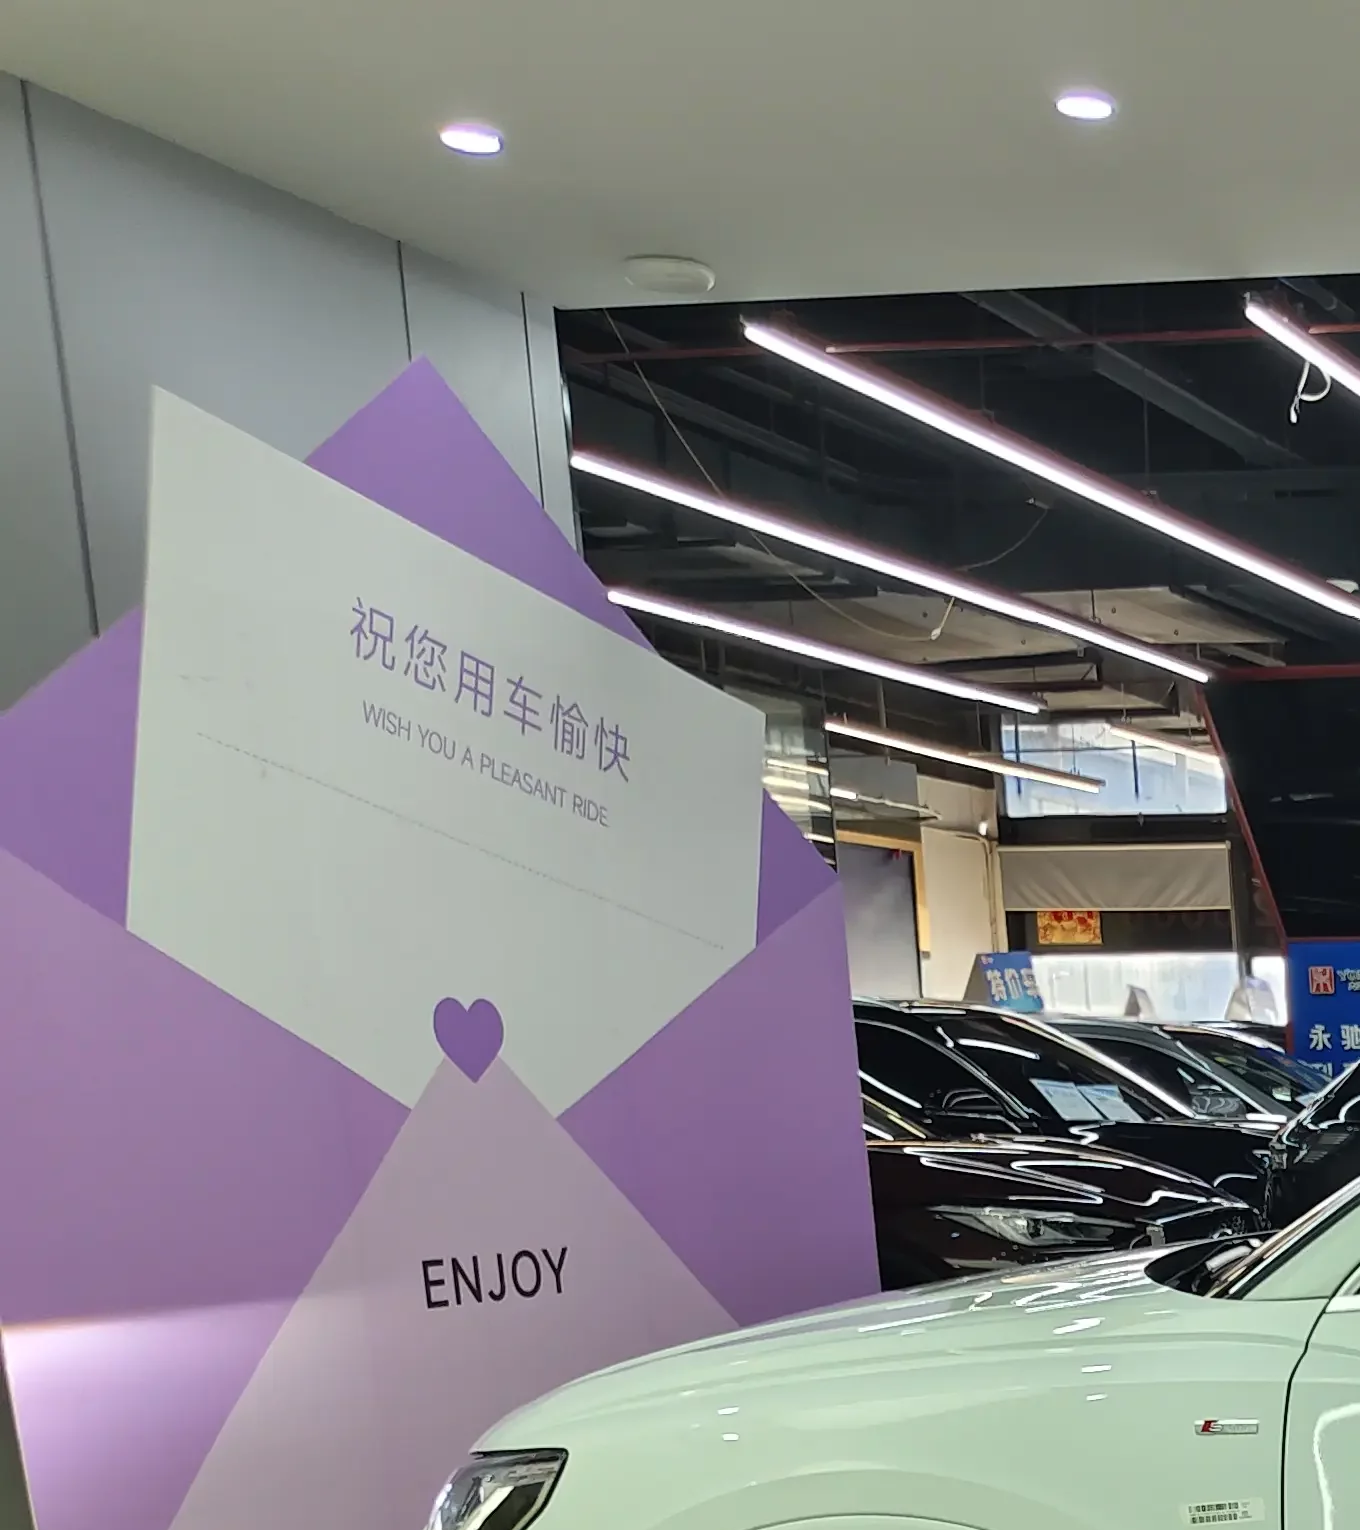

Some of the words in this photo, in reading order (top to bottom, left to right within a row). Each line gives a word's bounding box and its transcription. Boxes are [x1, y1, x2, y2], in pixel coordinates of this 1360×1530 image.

[350, 596, 631, 783] 祝您用车愉快
[362, 699, 412, 742] WISH
[417, 723, 456, 761] YOU
[460, 746, 475, 770] A
[480, 752, 567, 808] PLEASANT
[572, 793, 611, 829] RIDE
[421, 1246, 568, 1309] ENJOY
